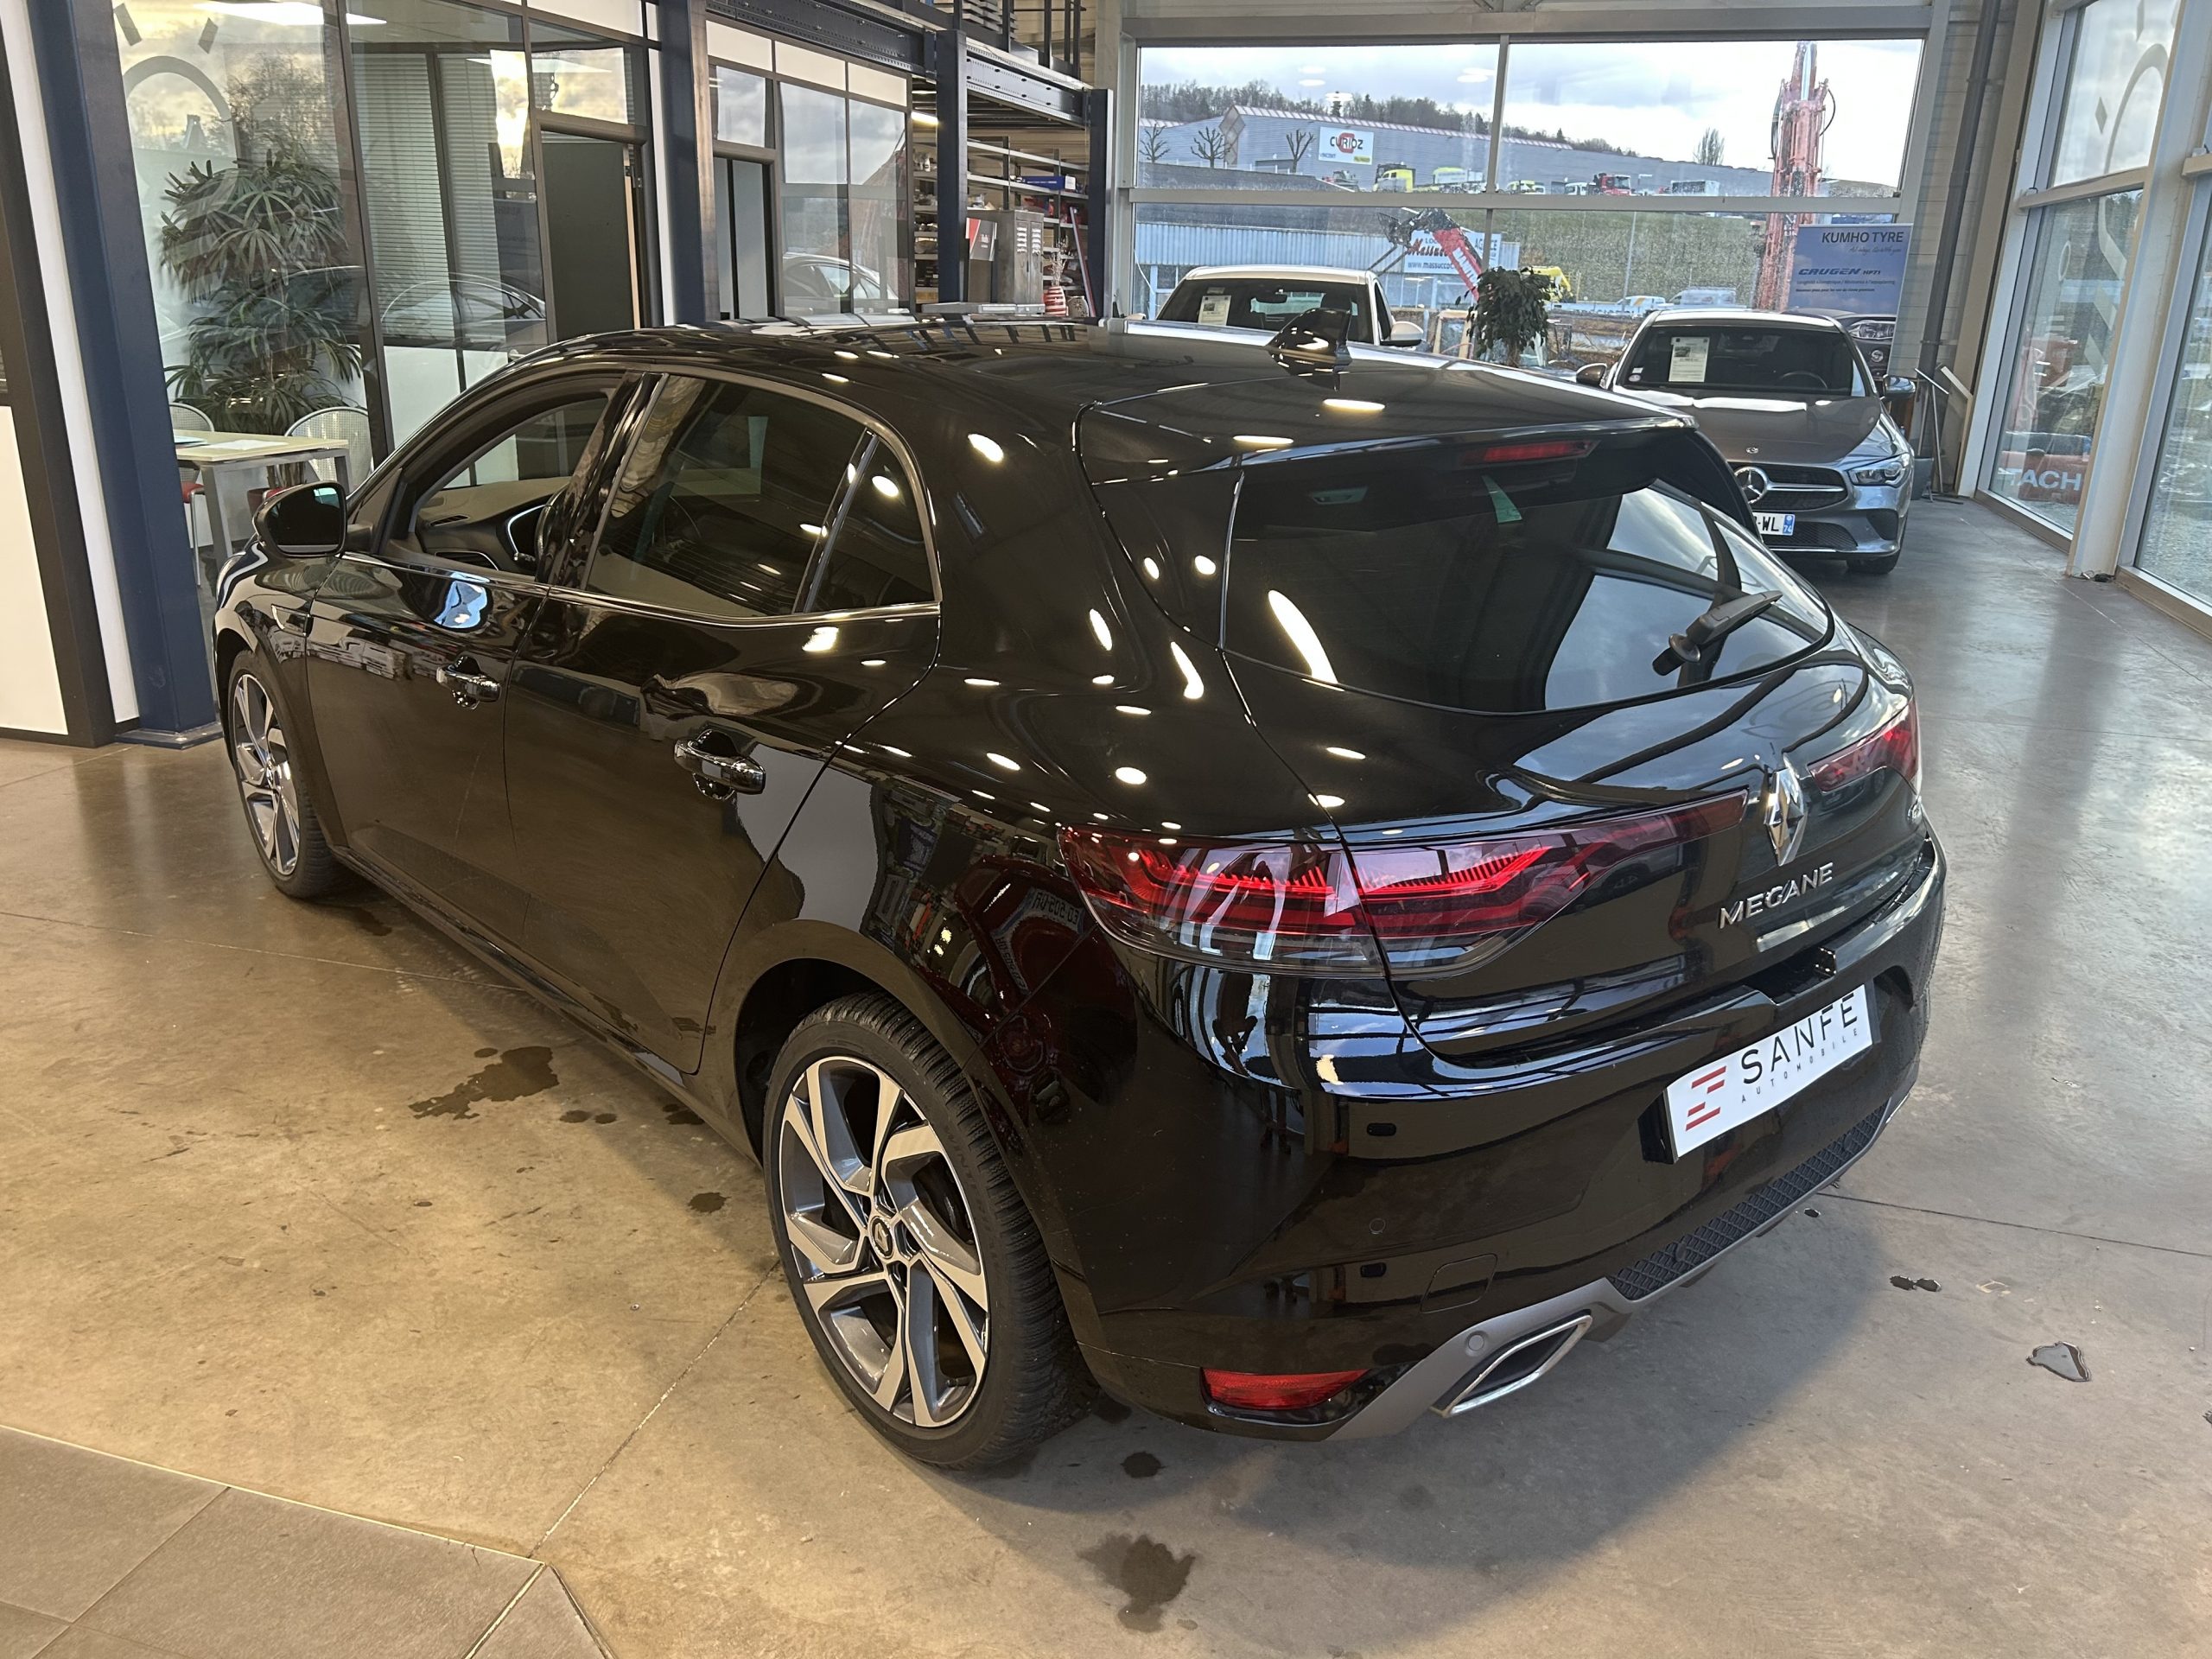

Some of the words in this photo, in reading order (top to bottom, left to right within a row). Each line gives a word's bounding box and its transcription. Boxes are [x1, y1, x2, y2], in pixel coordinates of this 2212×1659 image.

[1330, 136, 1363, 149] CURIOZ
[1821, 232, 1870, 243] KUMHO
[1872, 232, 1904, 243] TYRE
[1719, 862, 1834, 930] MEGANE
[1741, 993, 1858, 1084] SANFE
[1741, 1028, 1858, 1103] AUTOMOBILE
